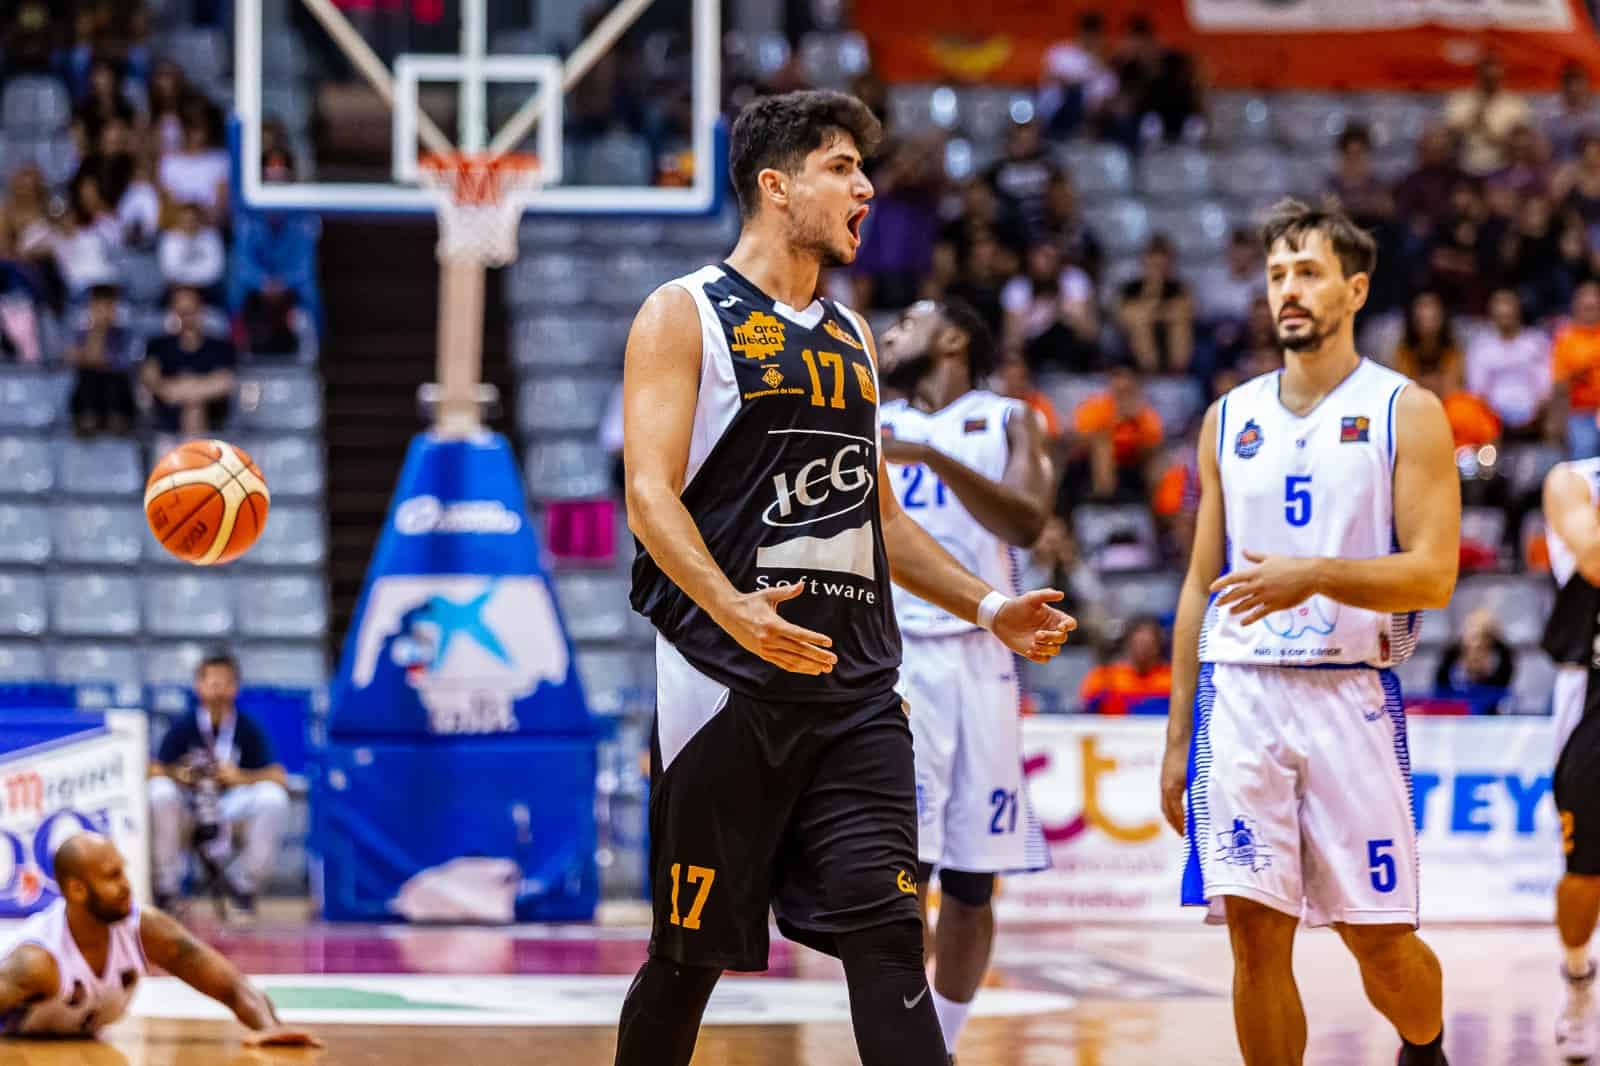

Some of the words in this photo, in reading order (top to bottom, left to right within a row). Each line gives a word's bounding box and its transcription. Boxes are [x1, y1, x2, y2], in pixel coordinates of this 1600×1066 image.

[736, 333, 779, 345] lleida
[802, 350, 846, 409] 17
[773, 444, 867, 517] ICG
[902, 463, 946, 509] 21
[1285, 475, 1312, 527] 5
[990, 788, 1017, 834] 21
[1367, 839, 1397, 893] 5
[670, 863, 715, 930] 17
